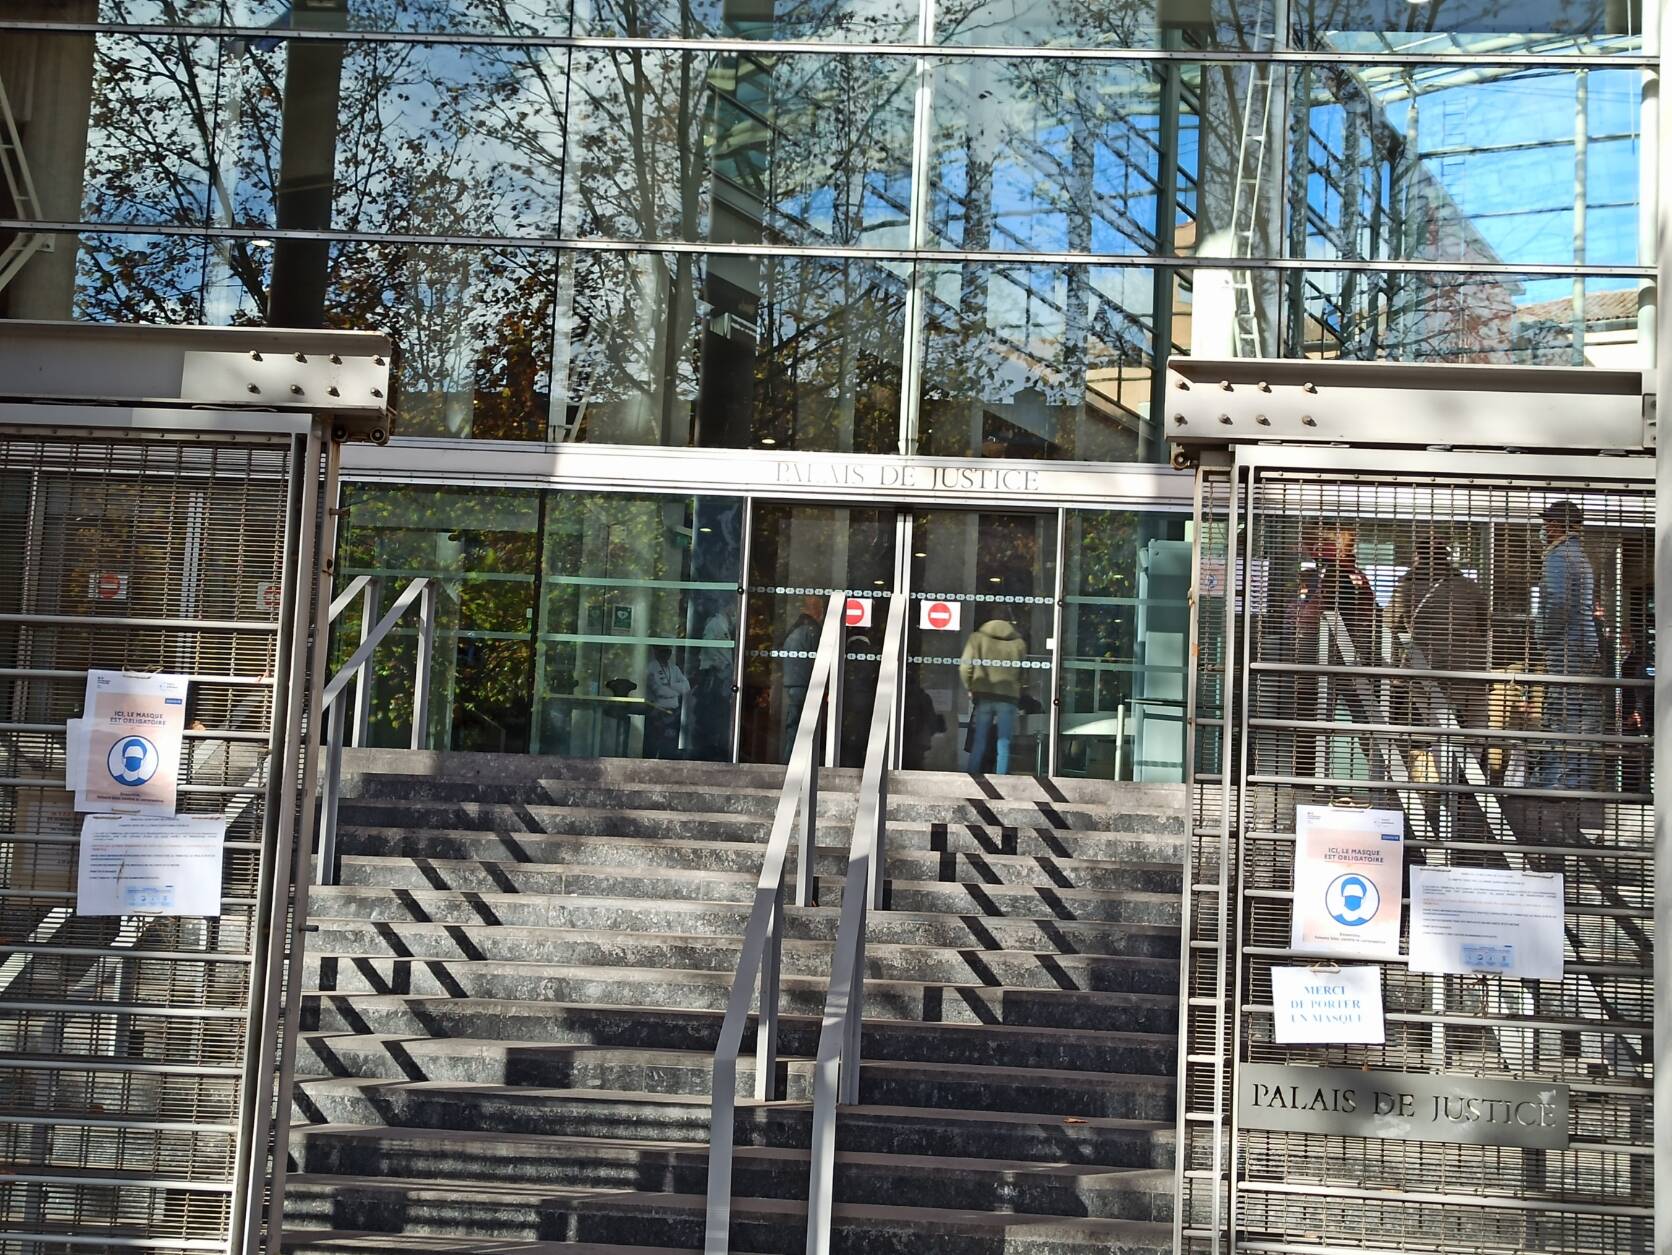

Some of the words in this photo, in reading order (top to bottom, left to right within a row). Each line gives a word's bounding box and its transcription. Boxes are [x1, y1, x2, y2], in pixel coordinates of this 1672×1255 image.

[776, 462, 864, 484] PALAIS
[880, 465, 915, 487] DE
[931, 467, 1039, 491] JUSTICE
[136, 711, 163, 719] MASQUE
[123, 717, 166, 725] OBLIGATOIRE
[1351, 848, 1380, 856] MASQUE
[1337, 854, 1384, 863] OBLIGATOIRE
[1304, 985, 1345, 995] MERCI
[1291, 999, 1304, 1009] DE
[1311, 999, 1361, 1009] PORTER
[1311, 1014, 1362, 1024] MASQUE
[1252, 1083, 1356, 1113] PALAIS
[1373, 1091, 1415, 1118] DE
[1432, 1095, 1557, 1127] JUSTICE
